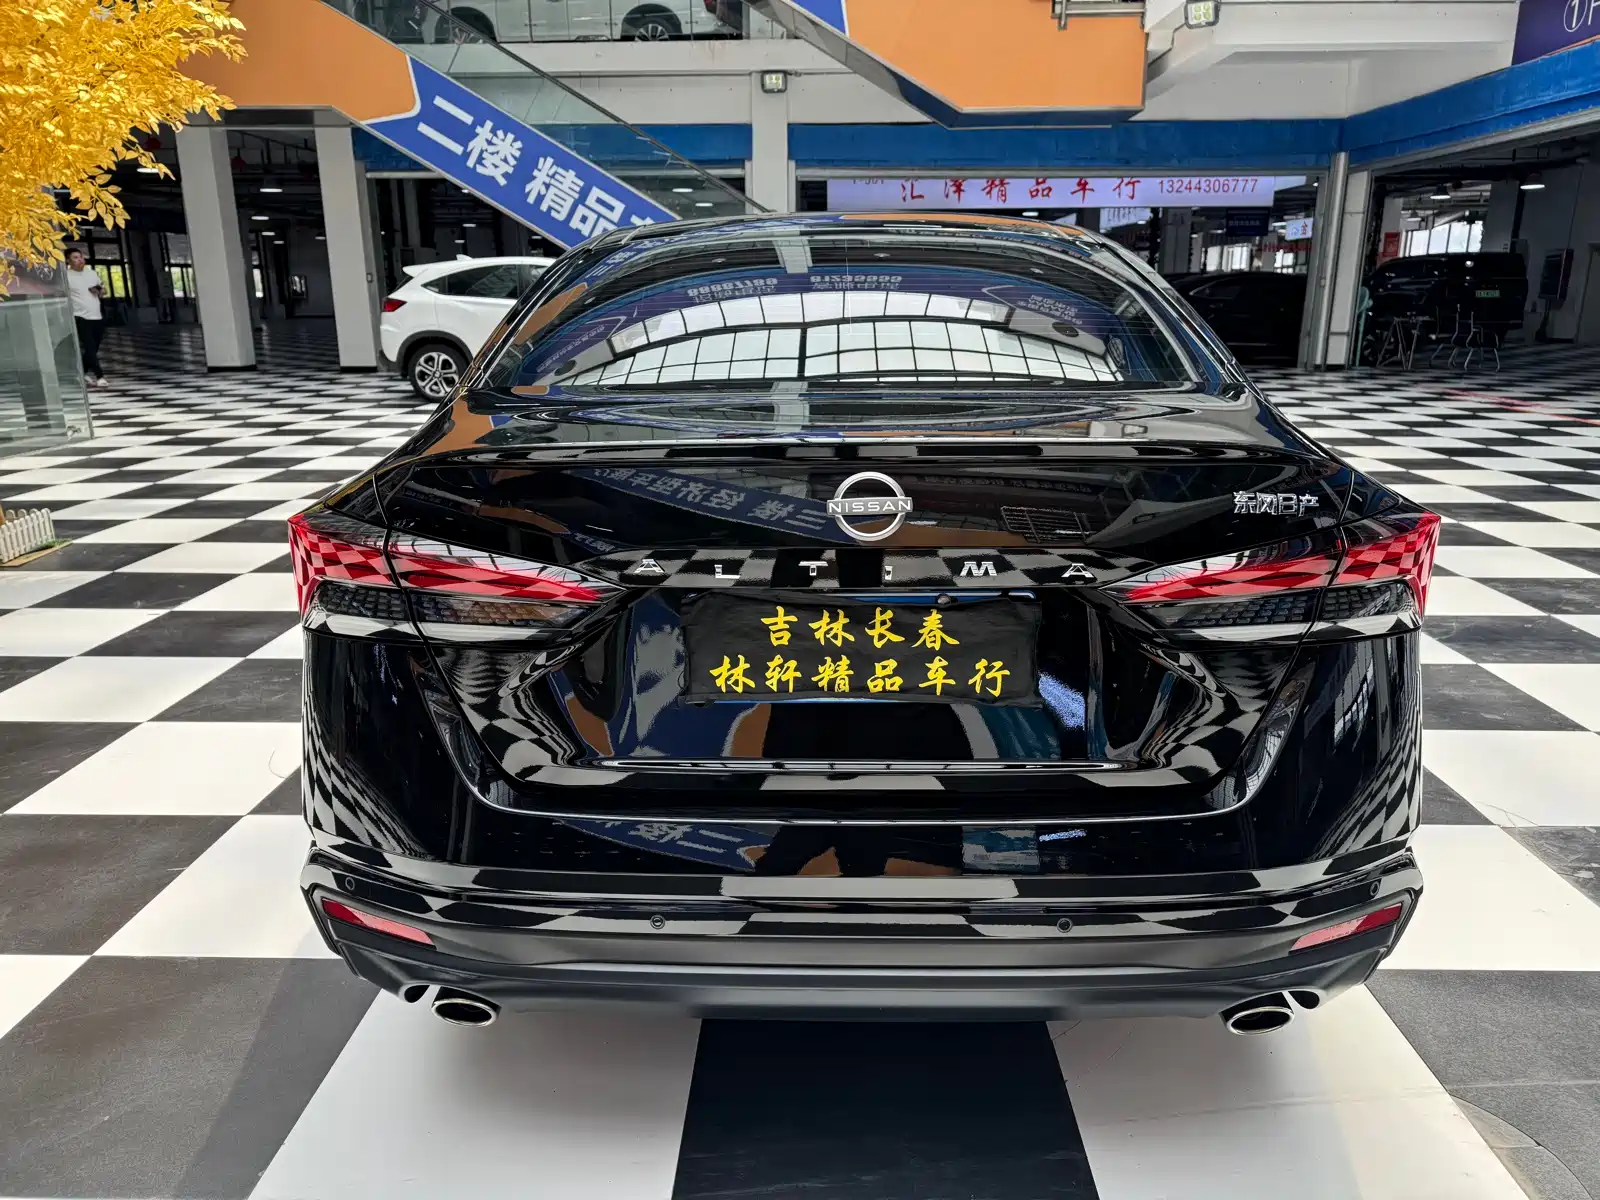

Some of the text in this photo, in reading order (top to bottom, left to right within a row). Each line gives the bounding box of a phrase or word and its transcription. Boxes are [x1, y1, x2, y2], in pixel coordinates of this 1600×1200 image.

[417, 95, 657, 237] 二楼 精品
[1158, 178, 1258, 194] 13244306777
[828, 499, 912, 513] NISSAN
[1233, 491, 1319, 517] 东风日产
[761, 605, 959, 651] 吉林长春
[709, 655, 1010, 697] 林轩精品车行
